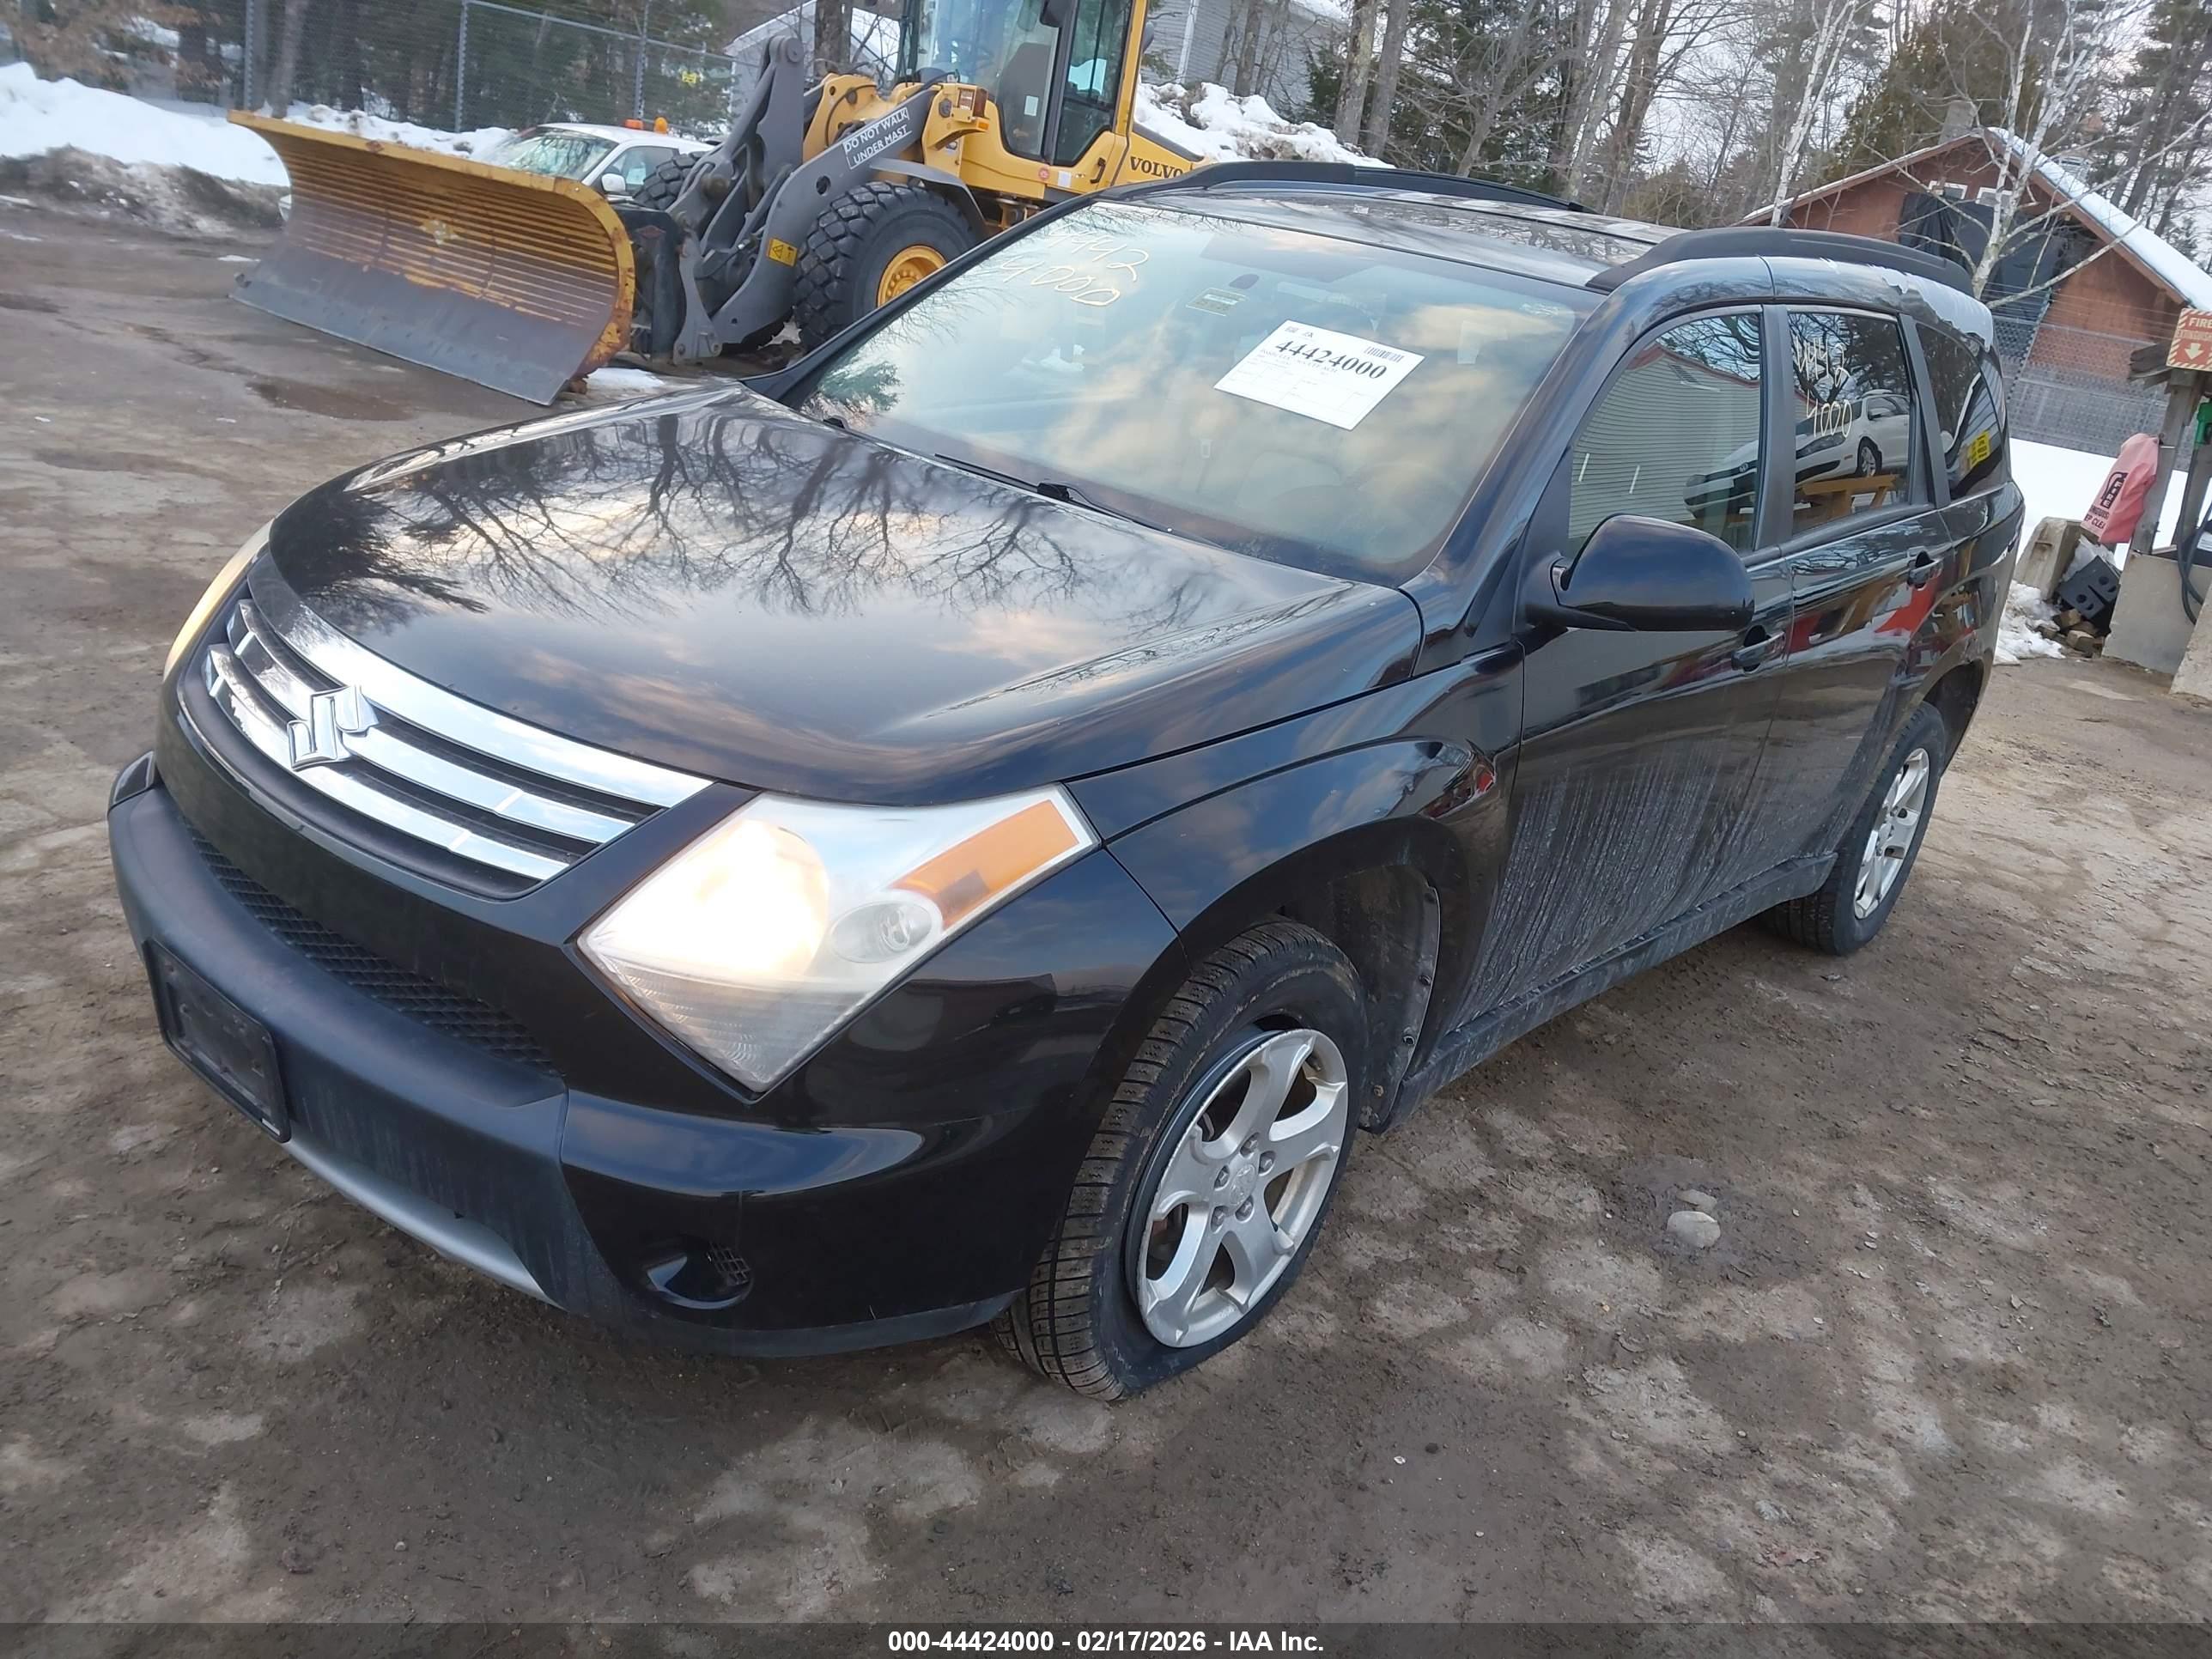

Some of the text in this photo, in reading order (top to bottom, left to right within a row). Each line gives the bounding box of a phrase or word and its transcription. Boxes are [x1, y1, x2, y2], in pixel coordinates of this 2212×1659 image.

[844, 109, 908, 153] DO NOT WALK
[853, 124, 908, 165] UNDER MAST
[2189, 317, 2212, 329] FIRE
[1274, 340, 1388, 380] 44424000
[1796, 336, 1852, 388] 4442
[1806, 389, 1853, 438] 4000
